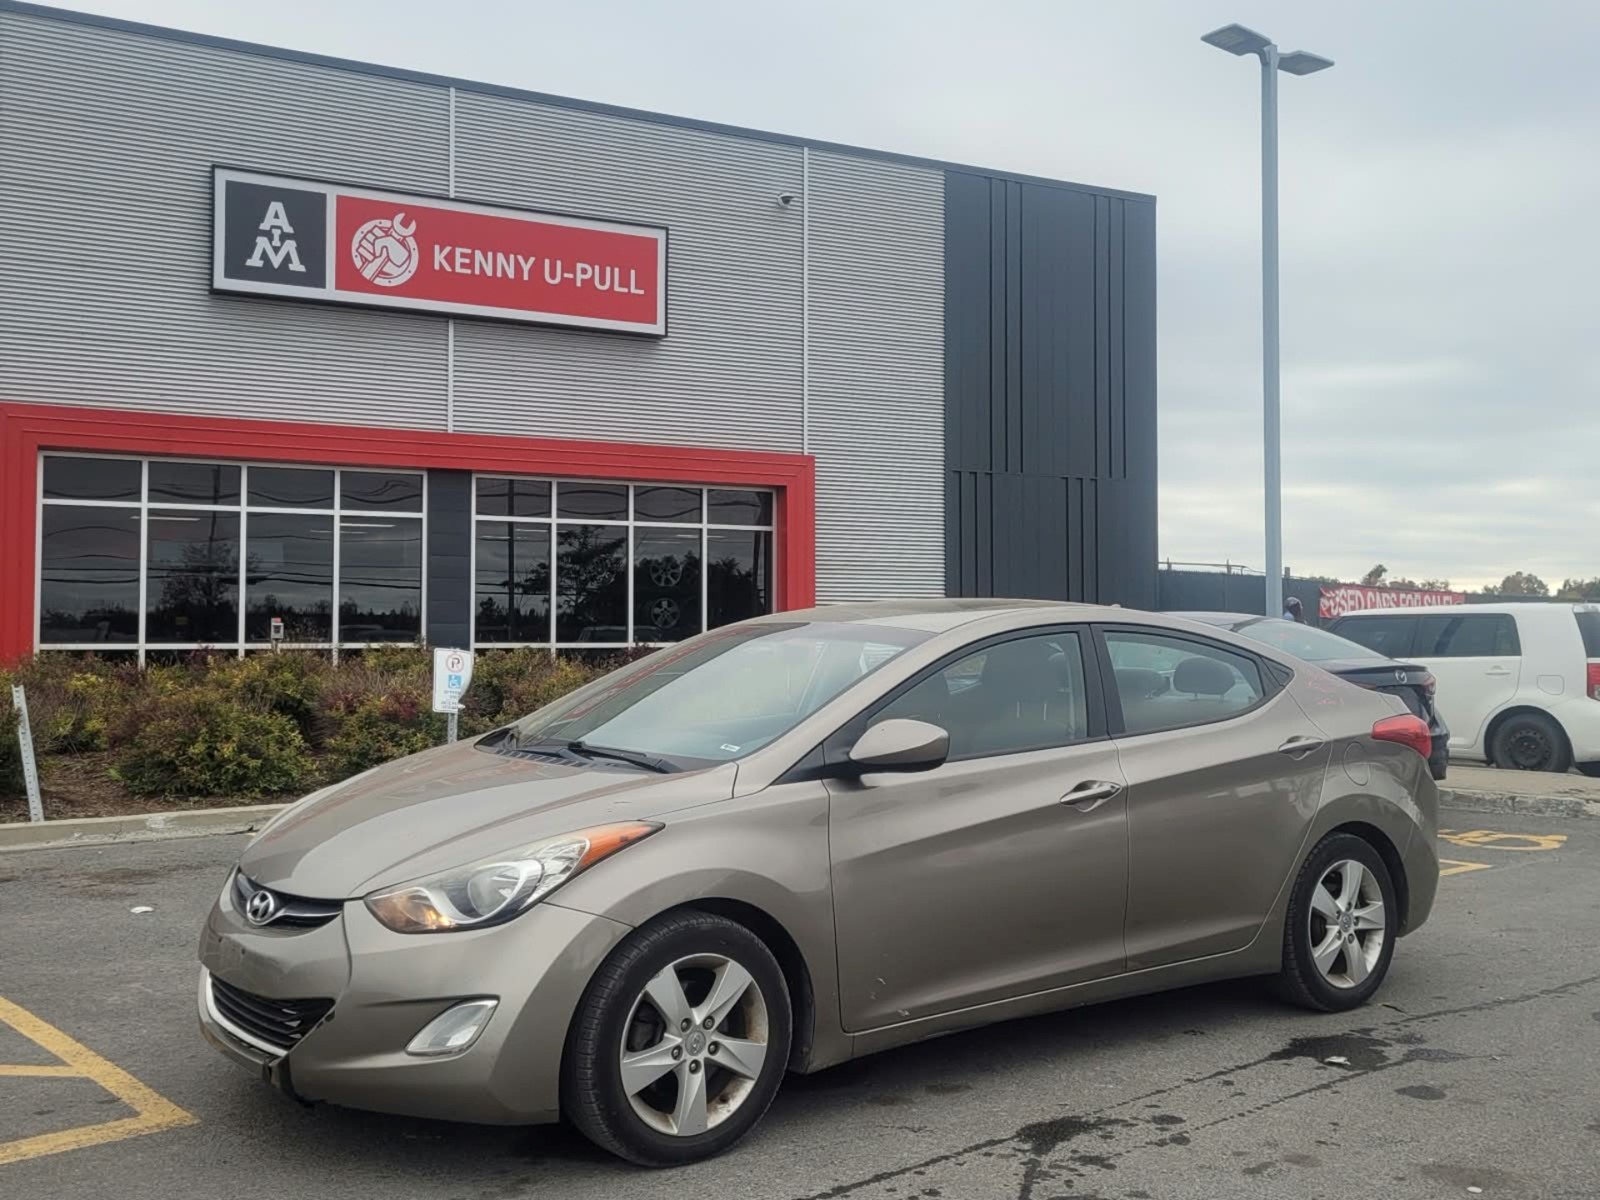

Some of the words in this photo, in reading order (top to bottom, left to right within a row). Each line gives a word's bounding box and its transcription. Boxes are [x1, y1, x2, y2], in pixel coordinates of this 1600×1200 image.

[433, 244, 536, 281] KENNY
[544, 258, 645, 295] U-PULL
[1330, 588, 1365, 615] USED
